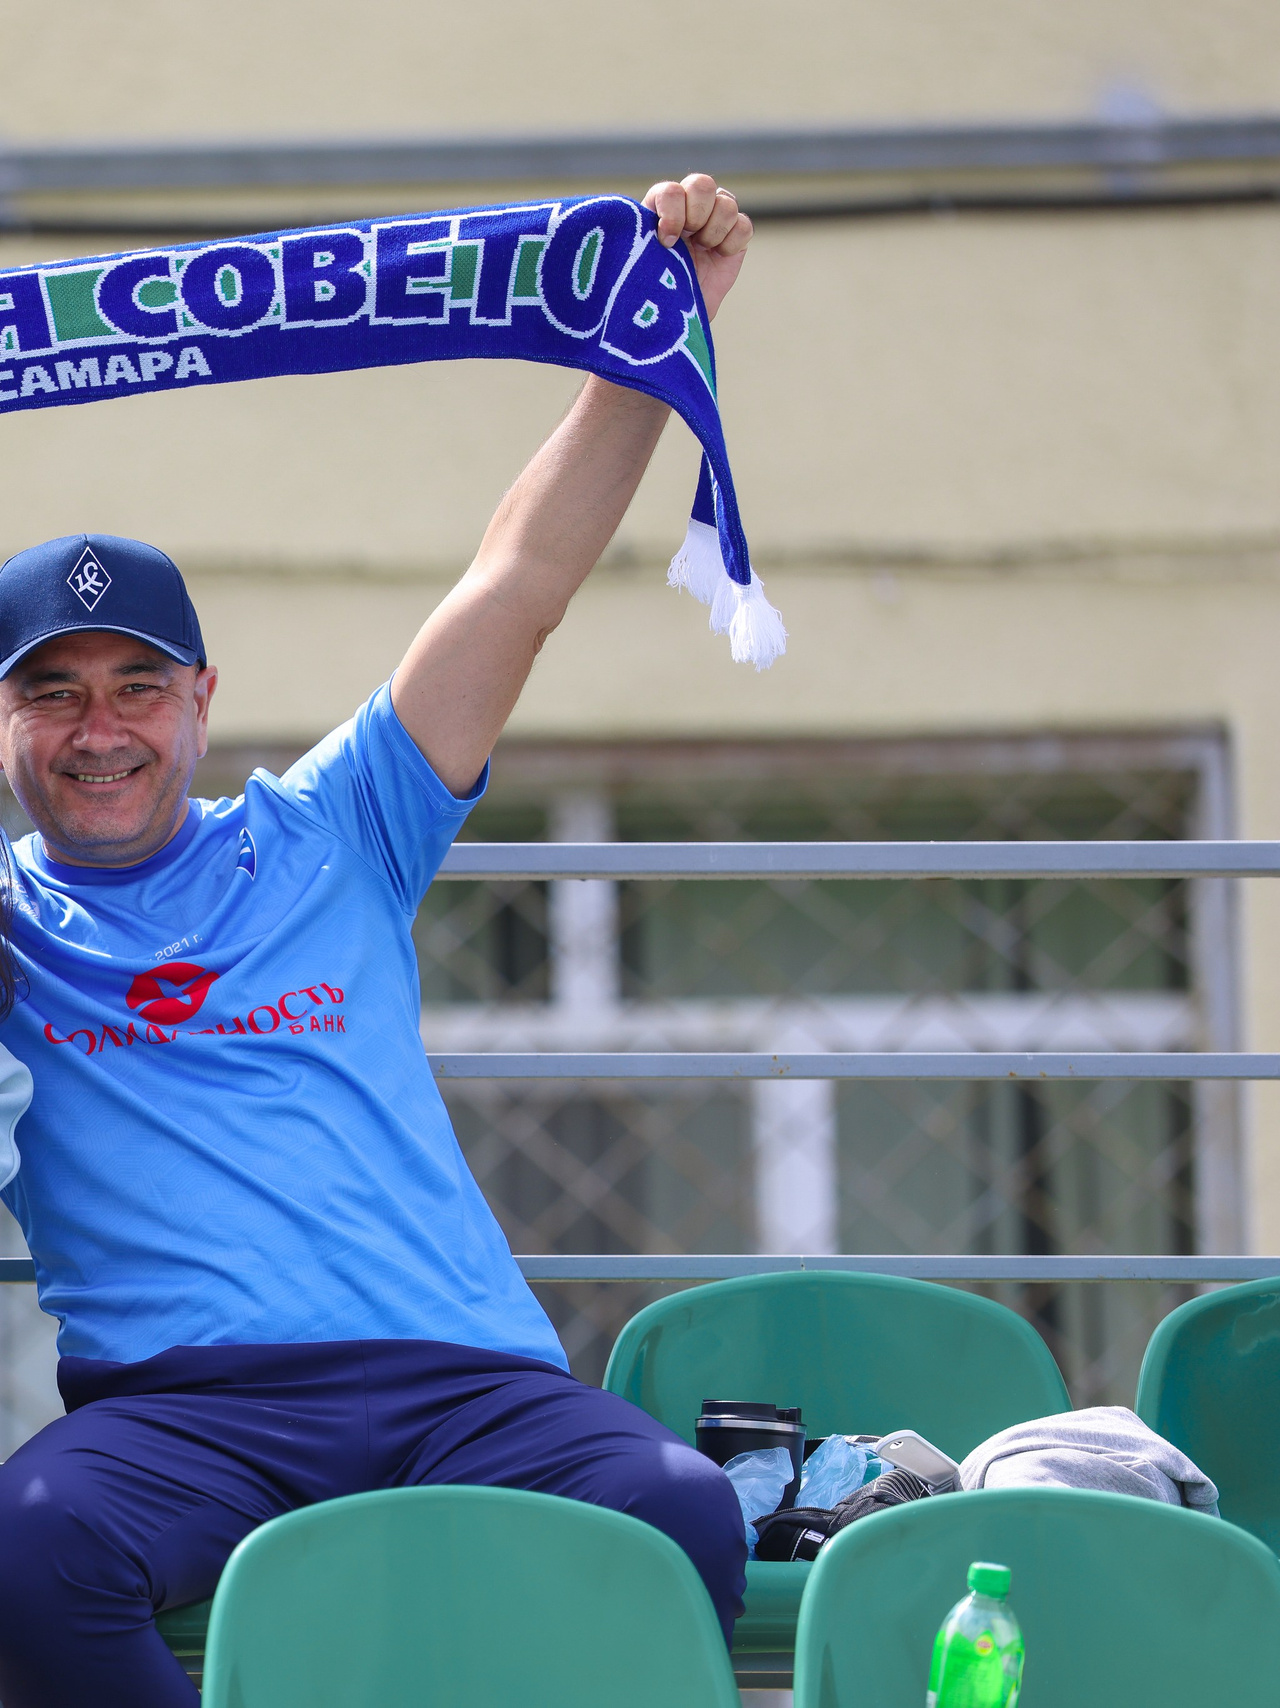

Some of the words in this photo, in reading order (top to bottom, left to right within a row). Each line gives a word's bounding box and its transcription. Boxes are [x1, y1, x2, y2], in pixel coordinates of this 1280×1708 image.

[94, 196, 697, 366] СОВЕТОВ
[154, 937, 190, 961] 2021
[287, 1014, 347, 1035] БАНК
